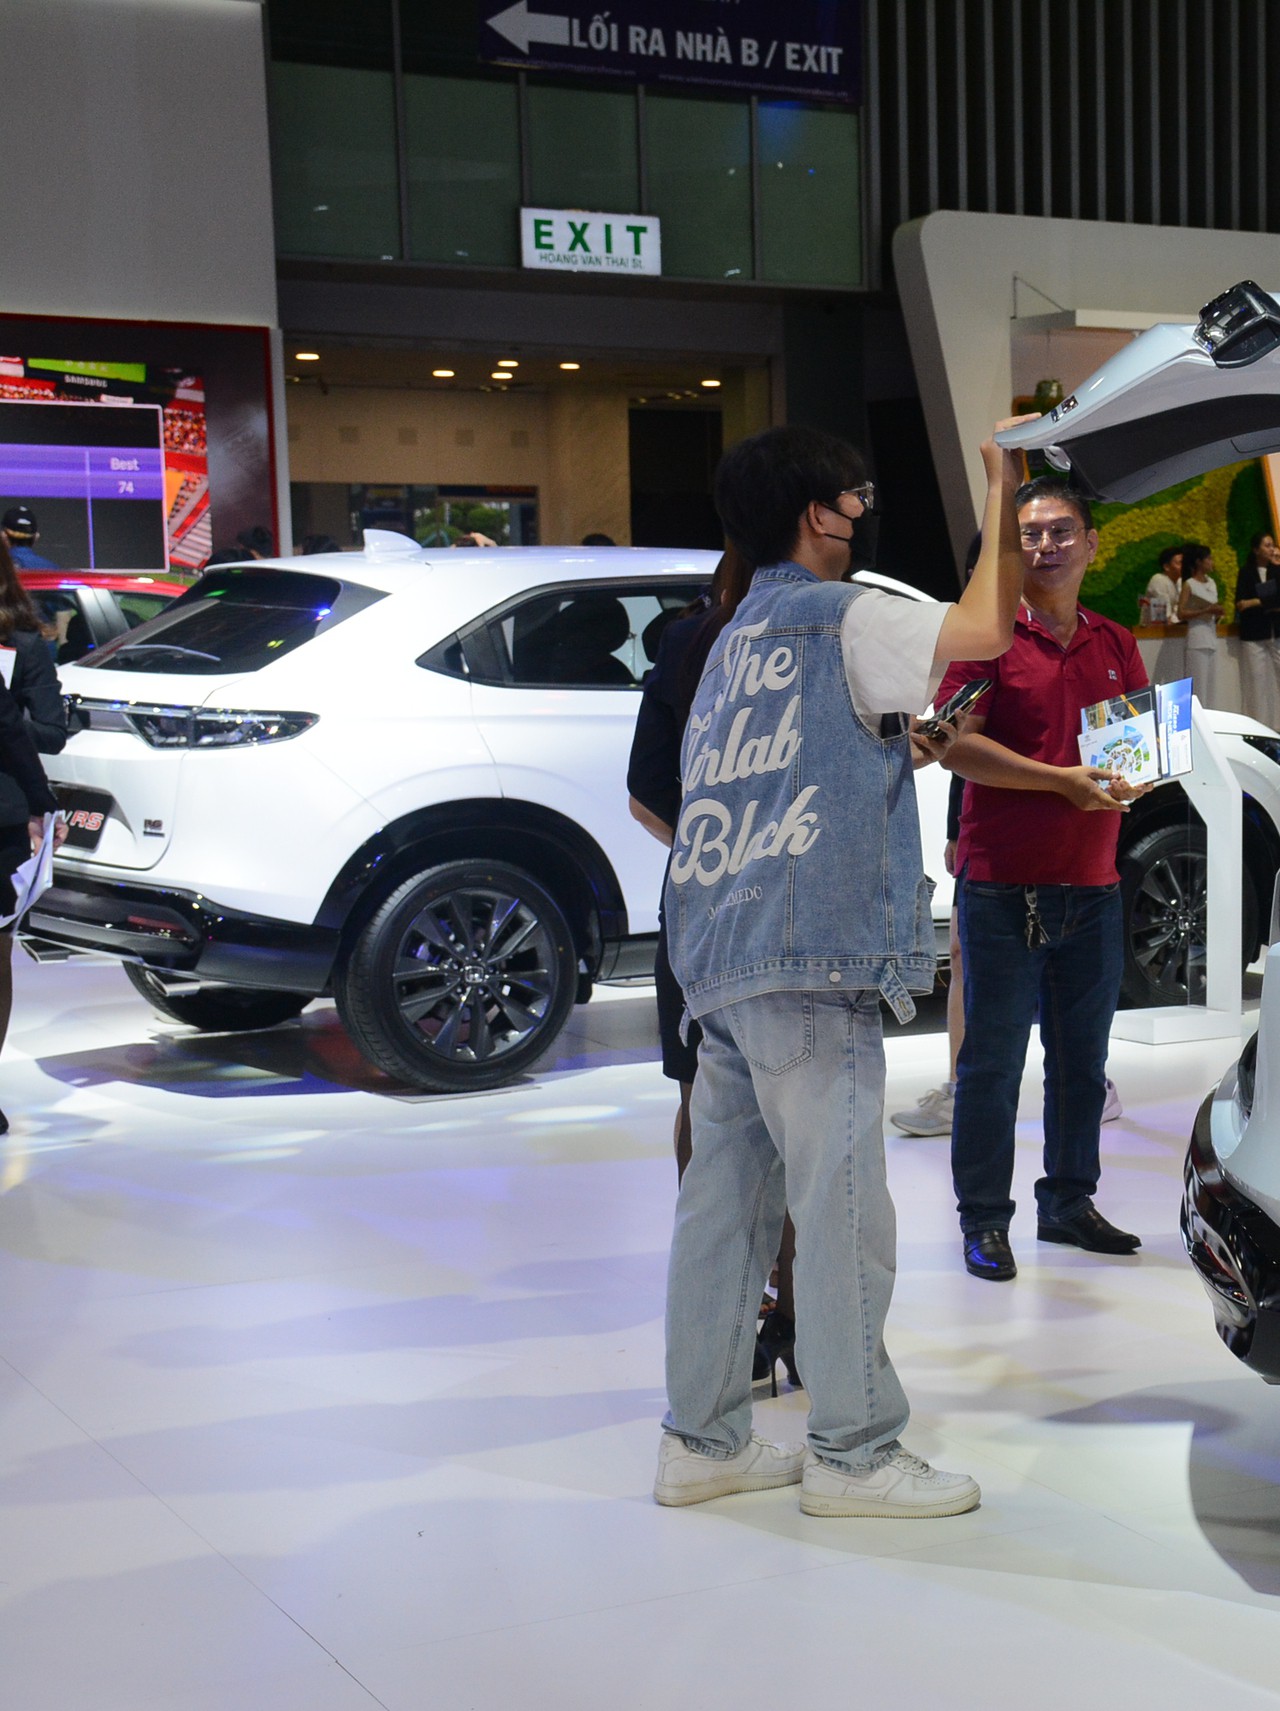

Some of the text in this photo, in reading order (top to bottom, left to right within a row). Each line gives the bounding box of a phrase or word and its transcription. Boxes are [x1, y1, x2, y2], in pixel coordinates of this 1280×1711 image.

[571, 11, 618, 51] LỐI
[628, 25, 667, 57] RA
[676, 27, 732, 64] NHÀ
[740, 38, 760, 66] B
[785, 43, 844, 75] EXIT
[533, 218, 648, 256] EXIT
[581, 255, 602, 266] VAN
[110, 457, 141, 471] Best
[118, 480, 135, 494] 74
[715, 618, 799, 713] The
[70, 809, 105, 831] RS
